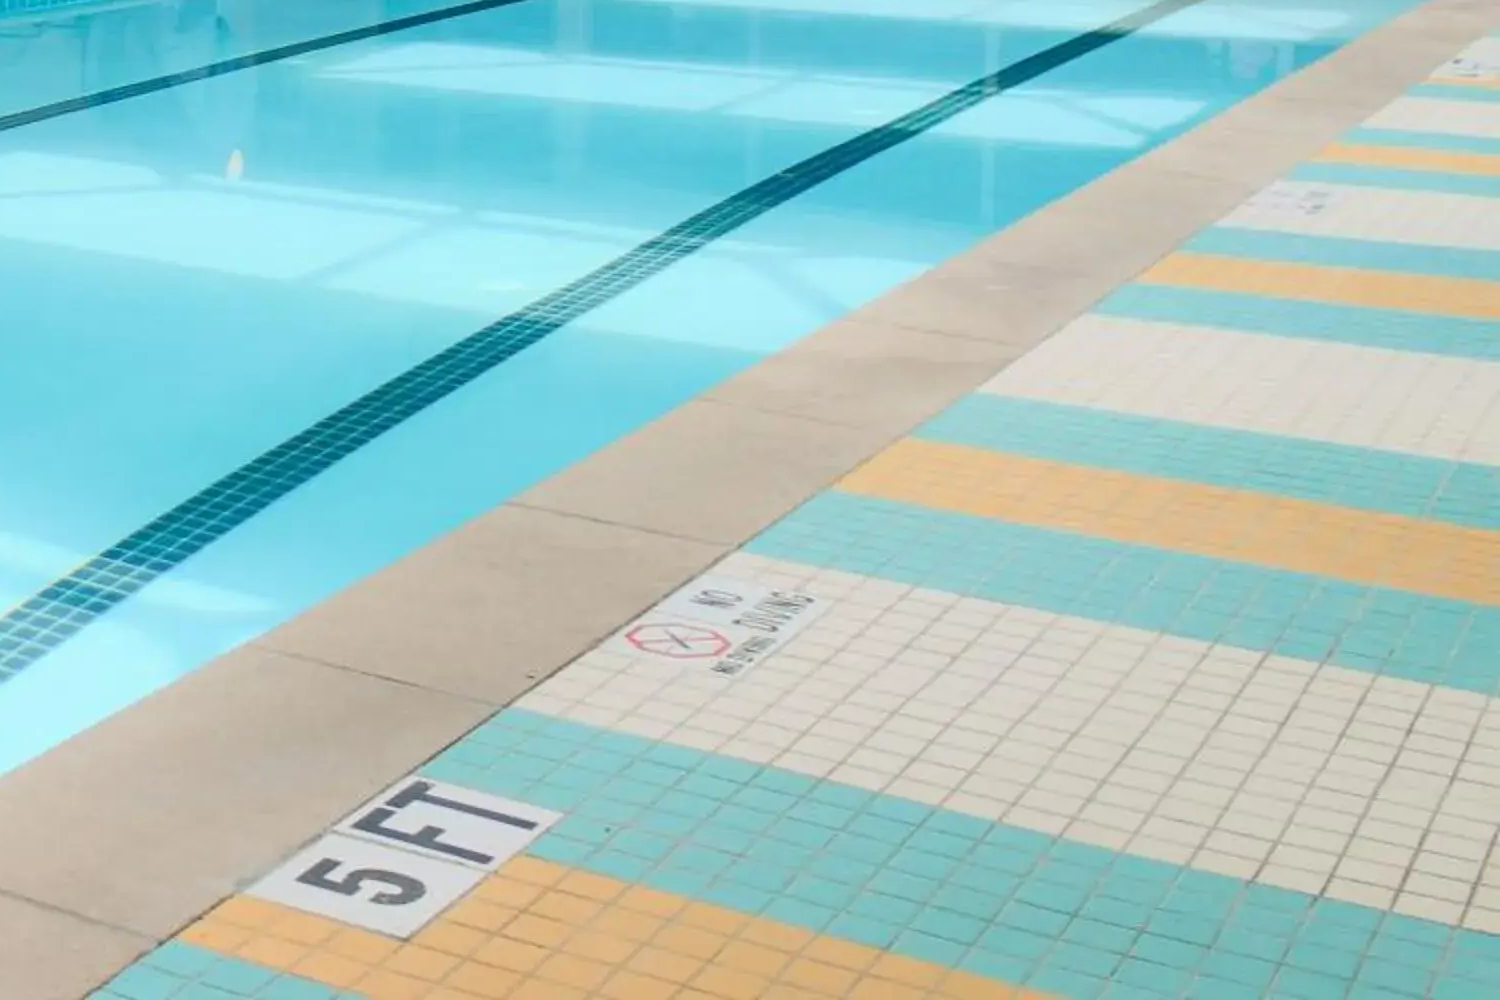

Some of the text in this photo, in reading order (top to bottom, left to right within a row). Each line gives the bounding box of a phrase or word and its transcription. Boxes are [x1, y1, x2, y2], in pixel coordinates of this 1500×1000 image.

[689, 588, 745, 611] NO
[295, 779, 540, 906] 5 FT
